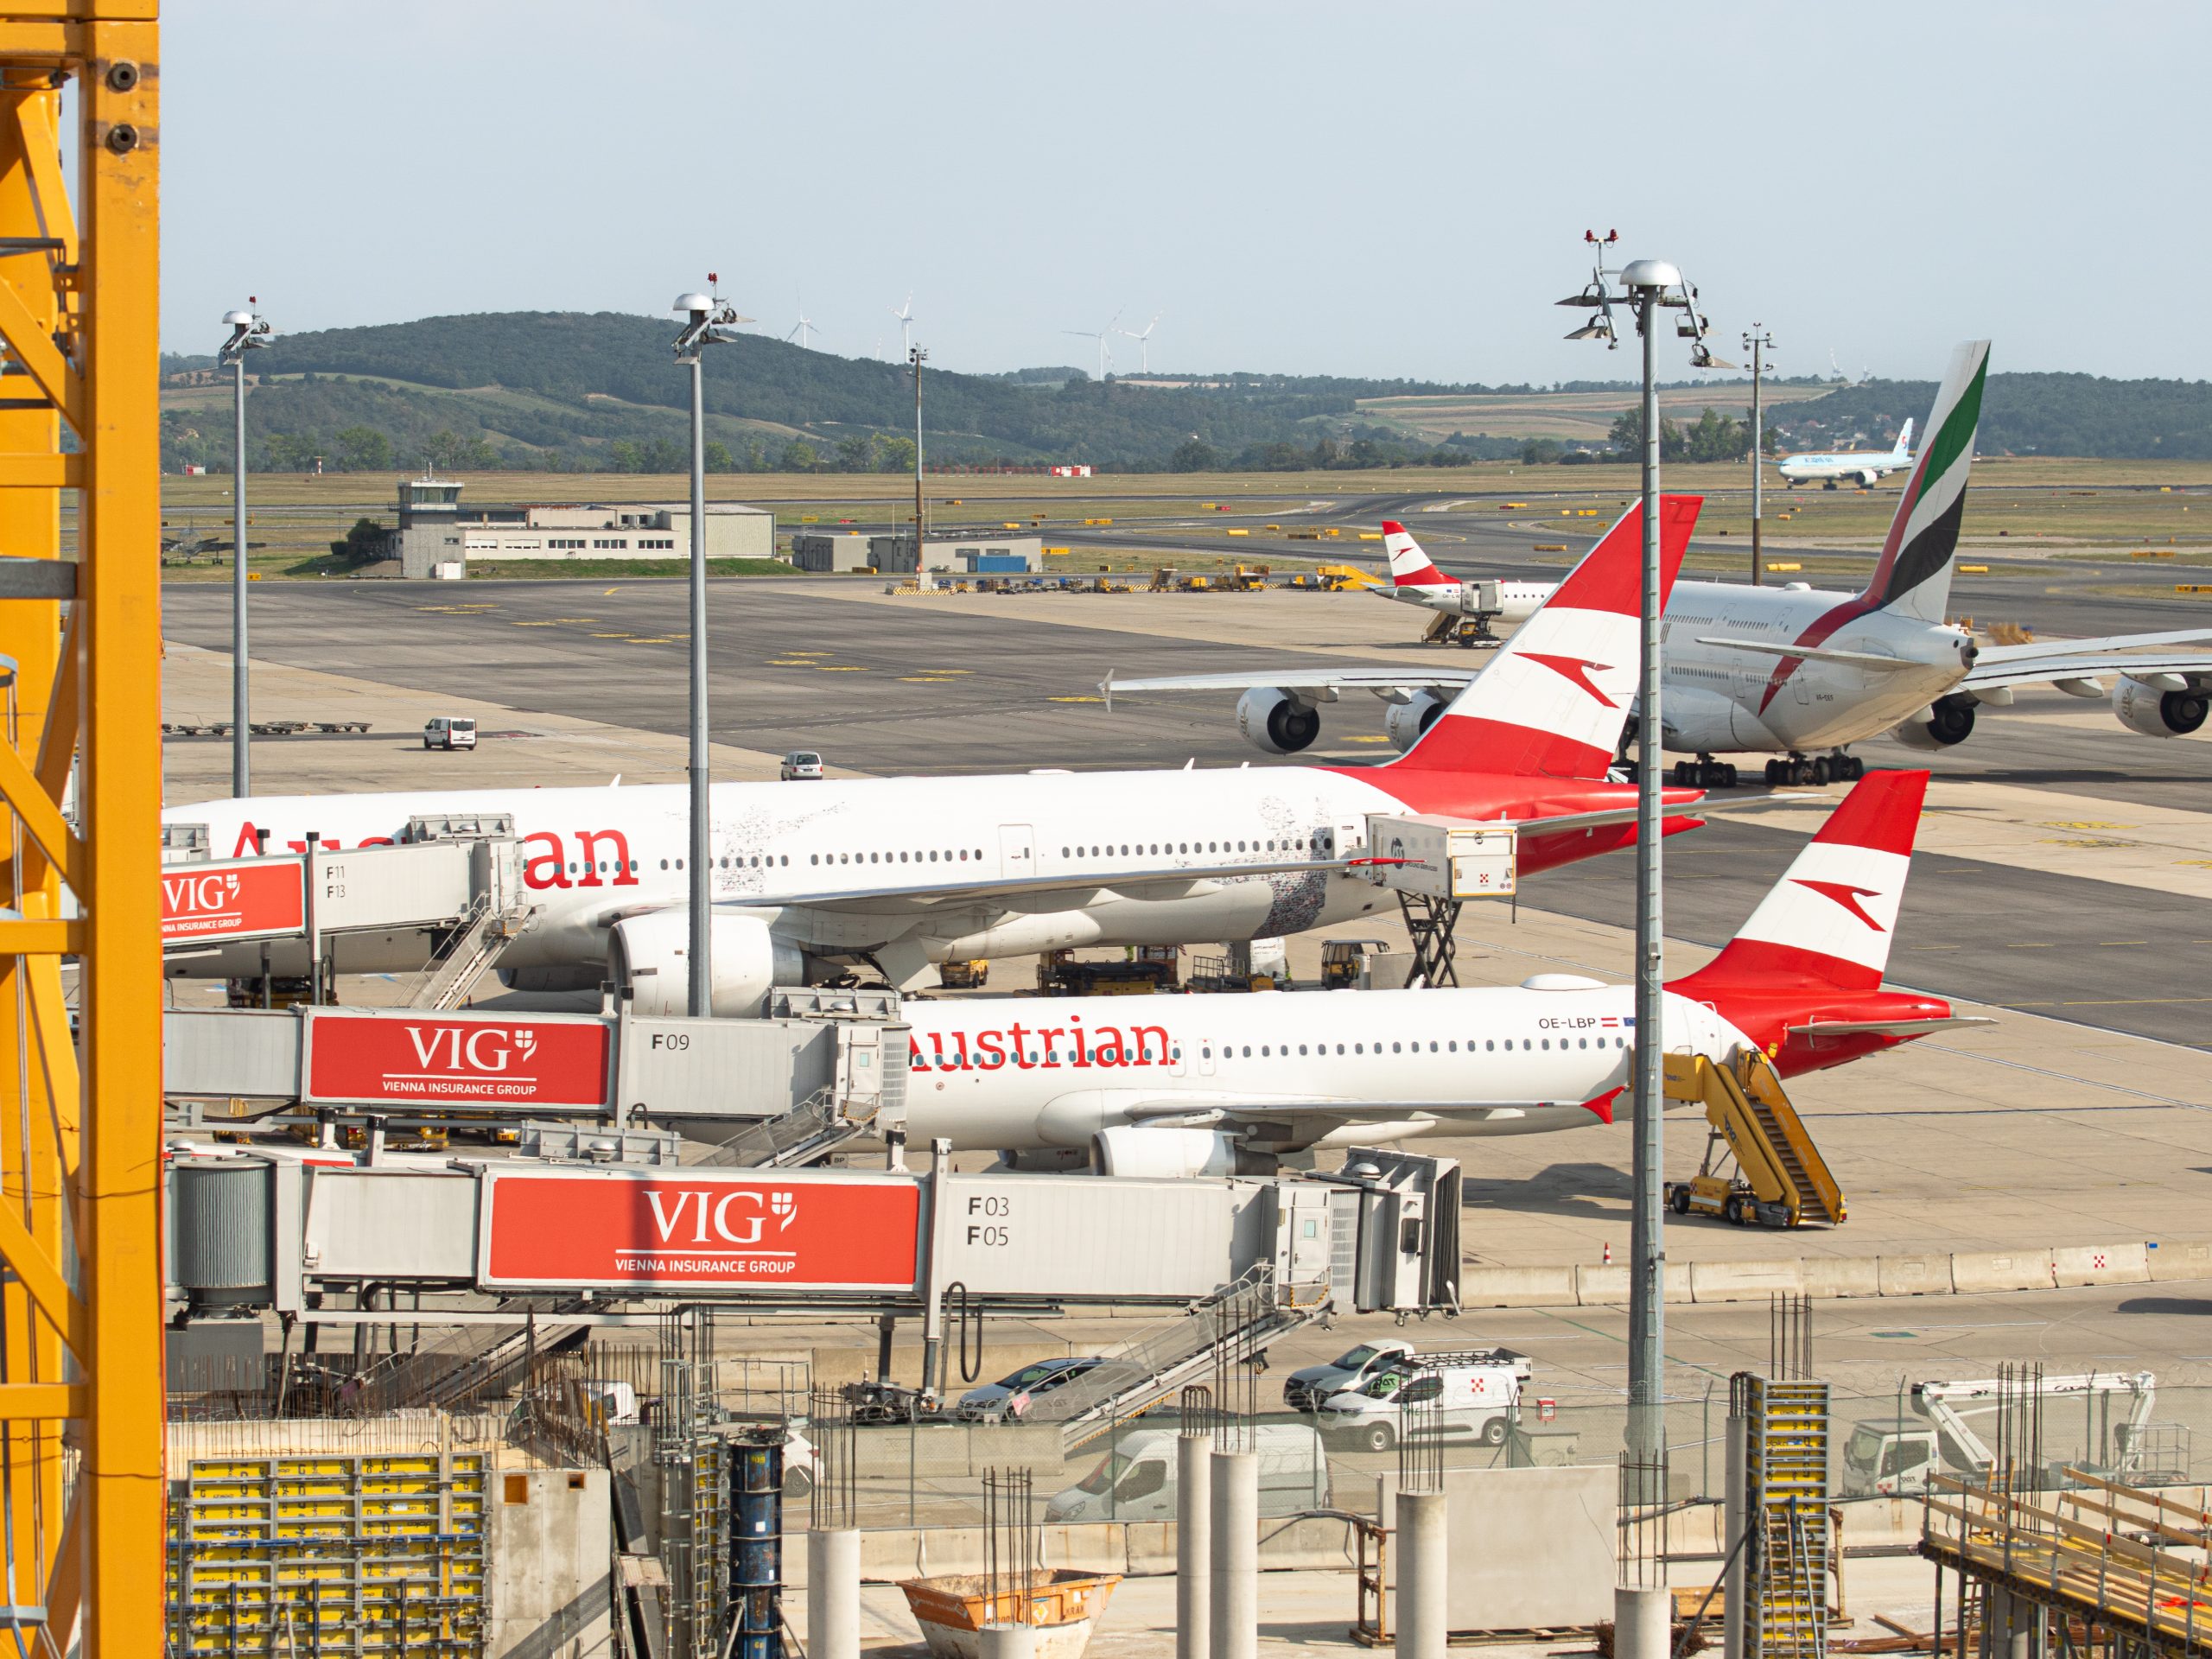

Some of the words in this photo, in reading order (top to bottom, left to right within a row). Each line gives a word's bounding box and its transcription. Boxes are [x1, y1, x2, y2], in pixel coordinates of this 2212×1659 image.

[327, 866, 345, 880] F11
[162, 875, 225, 912] VIG
[327, 885, 346, 899] F13
[177, 920, 217, 931] INSURANCE
[218, 918, 242, 928] GROUP
[1539, 1018, 1596, 1029] OE-LBP
[404, 1027, 512, 1071] VIG
[652, 1034, 690, 1051] F09
[383, 1081, 426, 1092] VIENNA
[428, 1083, 494, 1095] INSURANCE
[496, 1084, 537, 1096] GROUP
[969, 1197, 1009, 1217] F03
[642, 1191, 767, 1243] VIG
[967, 1225, 1008, 1246] F05
[615, 1259, 666, 1272] VIENNA
[669, 1260, 746, 1273] INSURANCE
[749, 1262, 796, 1274] GROUP
